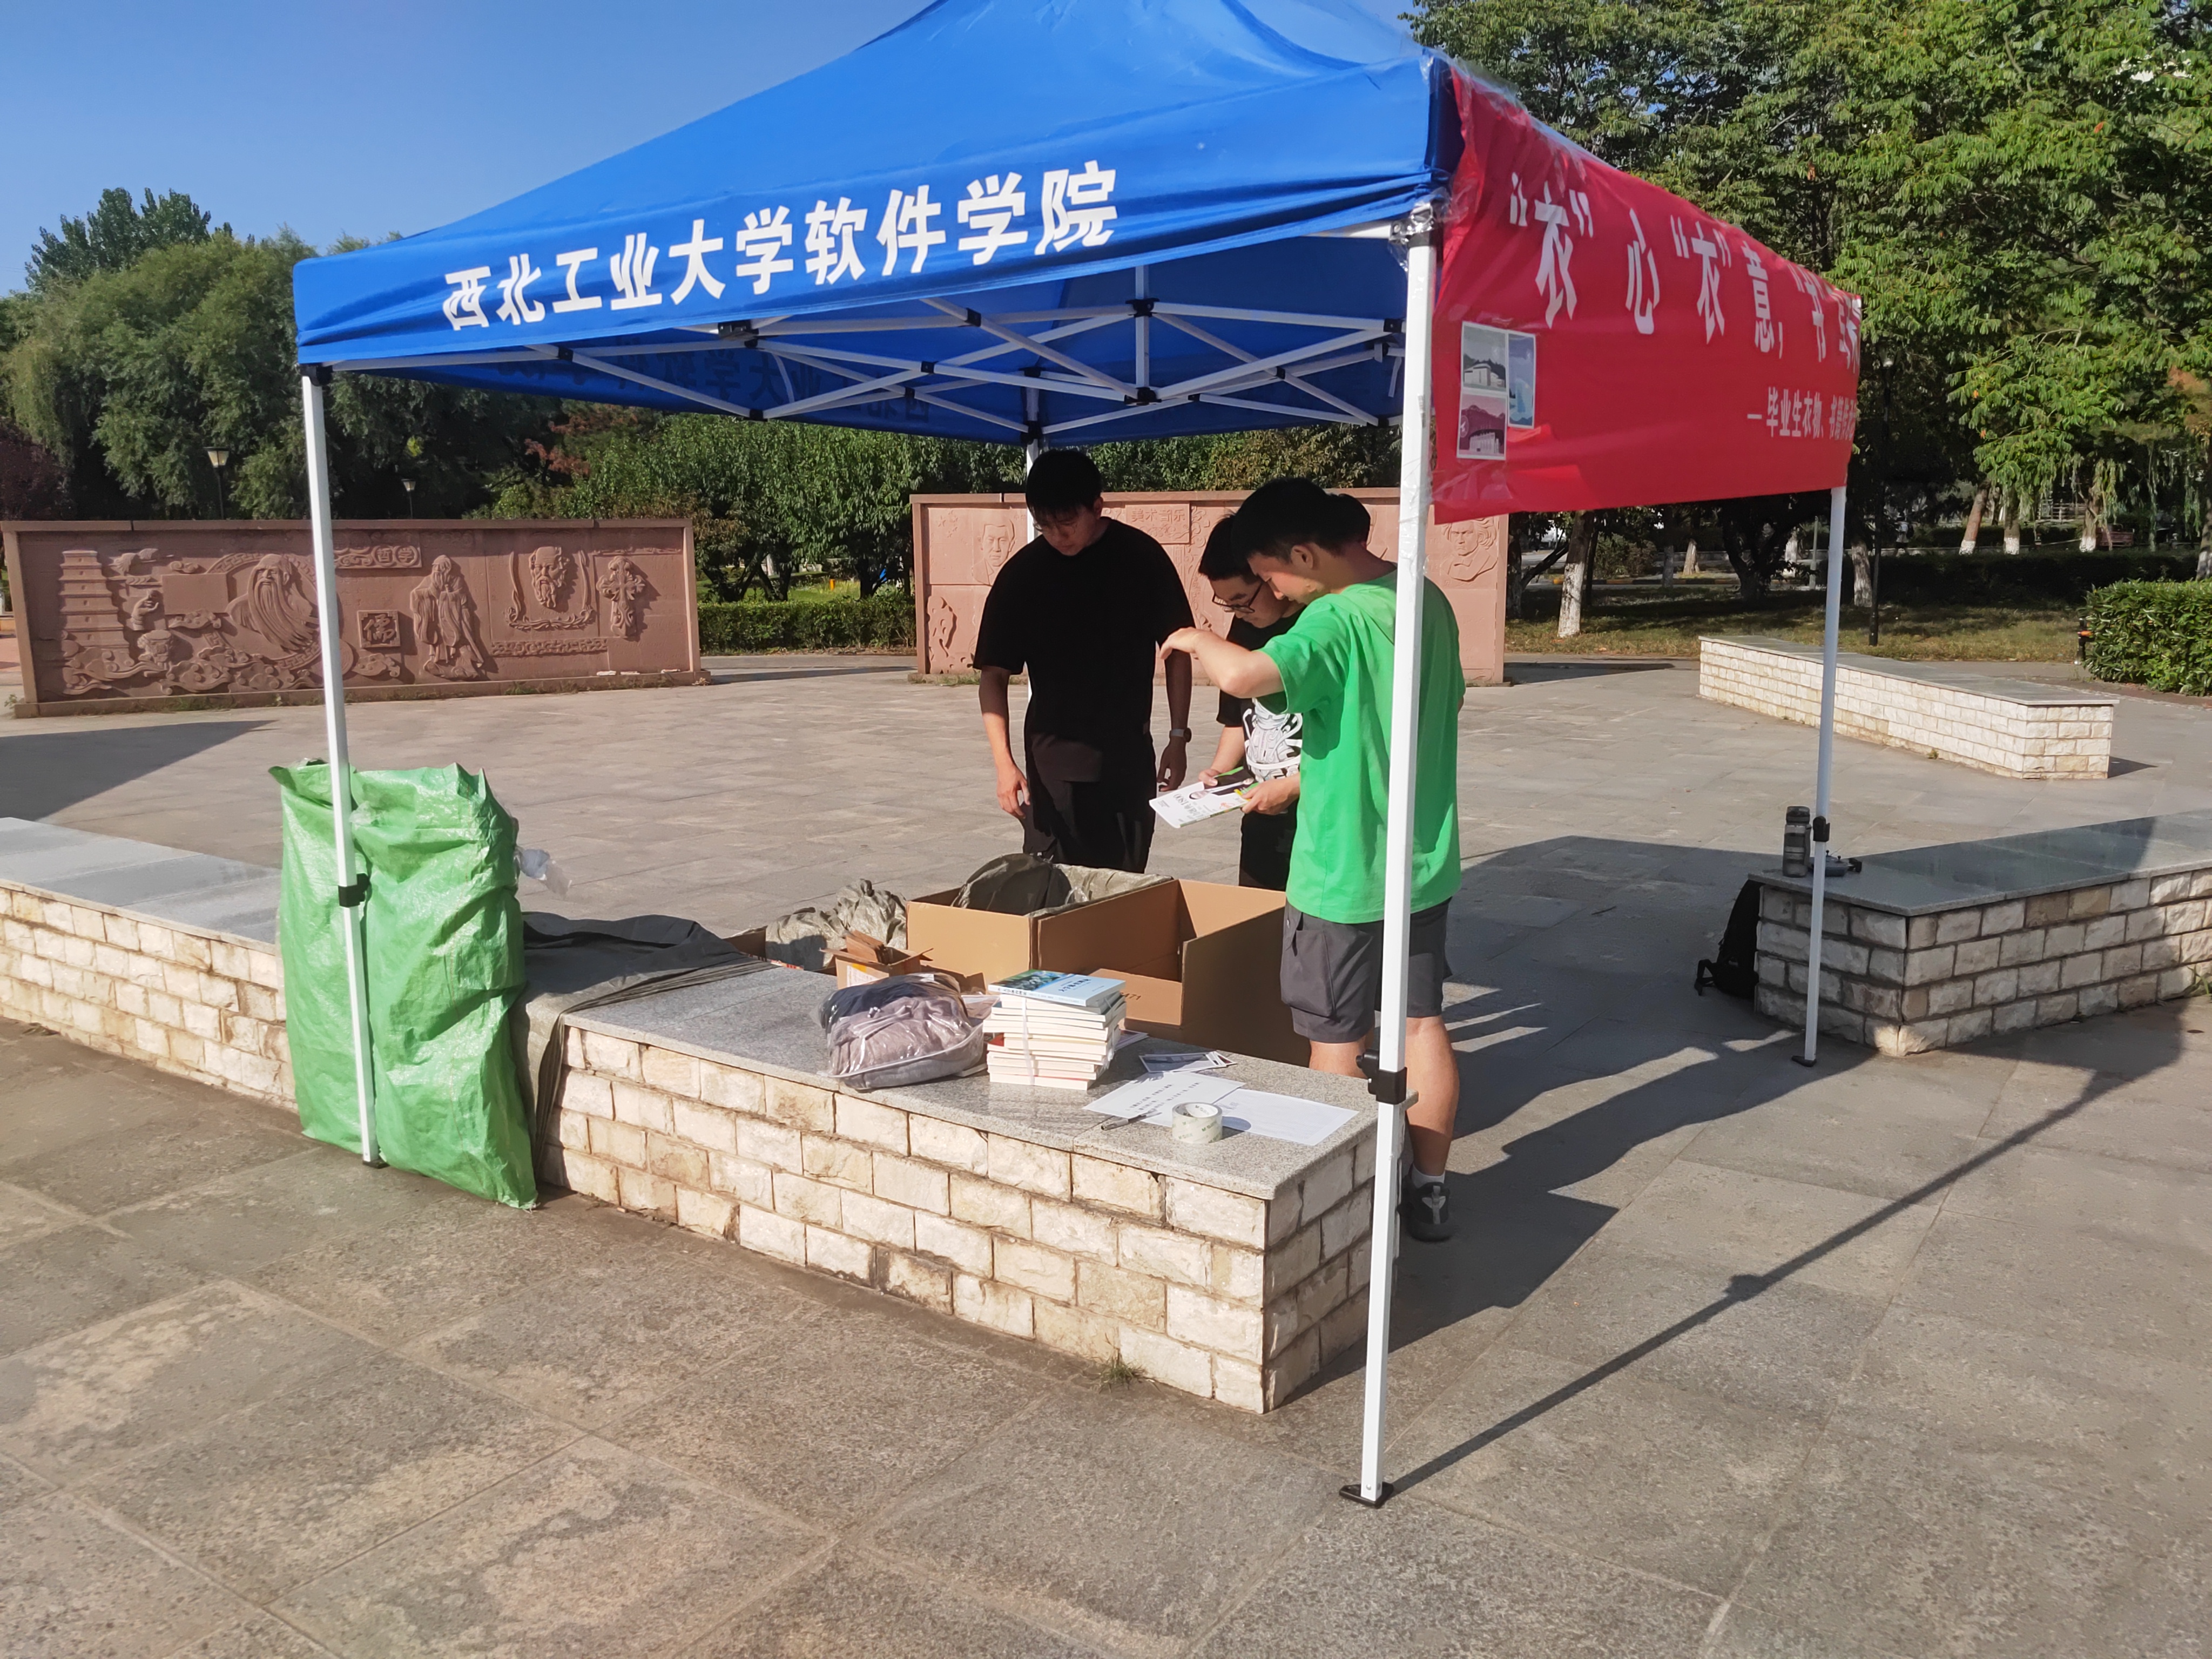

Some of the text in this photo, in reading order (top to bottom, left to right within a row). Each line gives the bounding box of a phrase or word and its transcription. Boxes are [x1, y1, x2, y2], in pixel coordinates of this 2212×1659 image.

[442, 160, 1118, 331] 西北工业大学软件学院
[1131, 508, 1186, 524] 美术音乐
[376, 547, 413, 564] 哲学
[363, 613, 396, 643] 儒
